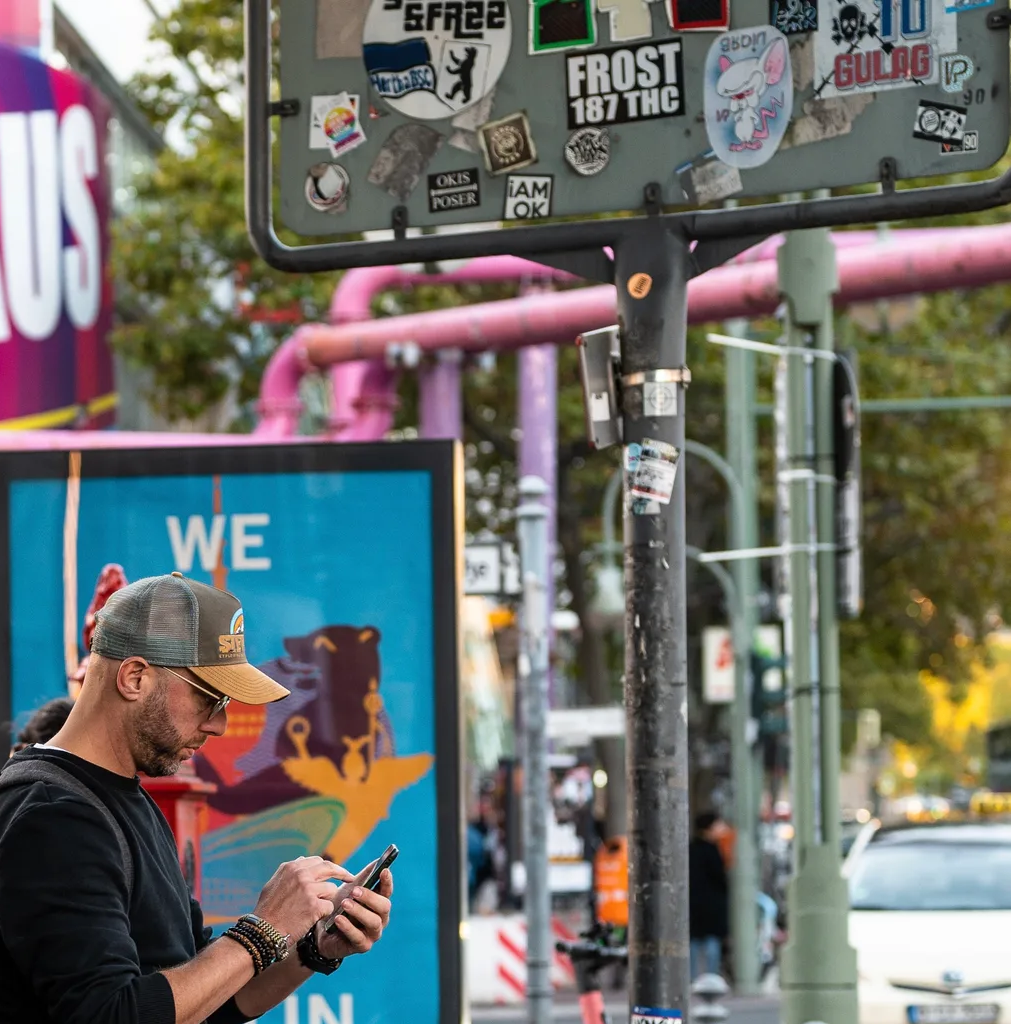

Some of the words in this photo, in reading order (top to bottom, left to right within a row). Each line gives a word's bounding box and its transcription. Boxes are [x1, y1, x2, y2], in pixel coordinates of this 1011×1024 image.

[567, 42, 680, 98] FROST
[835, 43, 934, 90] GULAG
[570, 94, 619, 125] 187
[623, 85, 680, 118] THC
[432, 191, 477, 210] POSER
[513, 200, 546, 219] OK
[166, 513, 272, 571] WE
